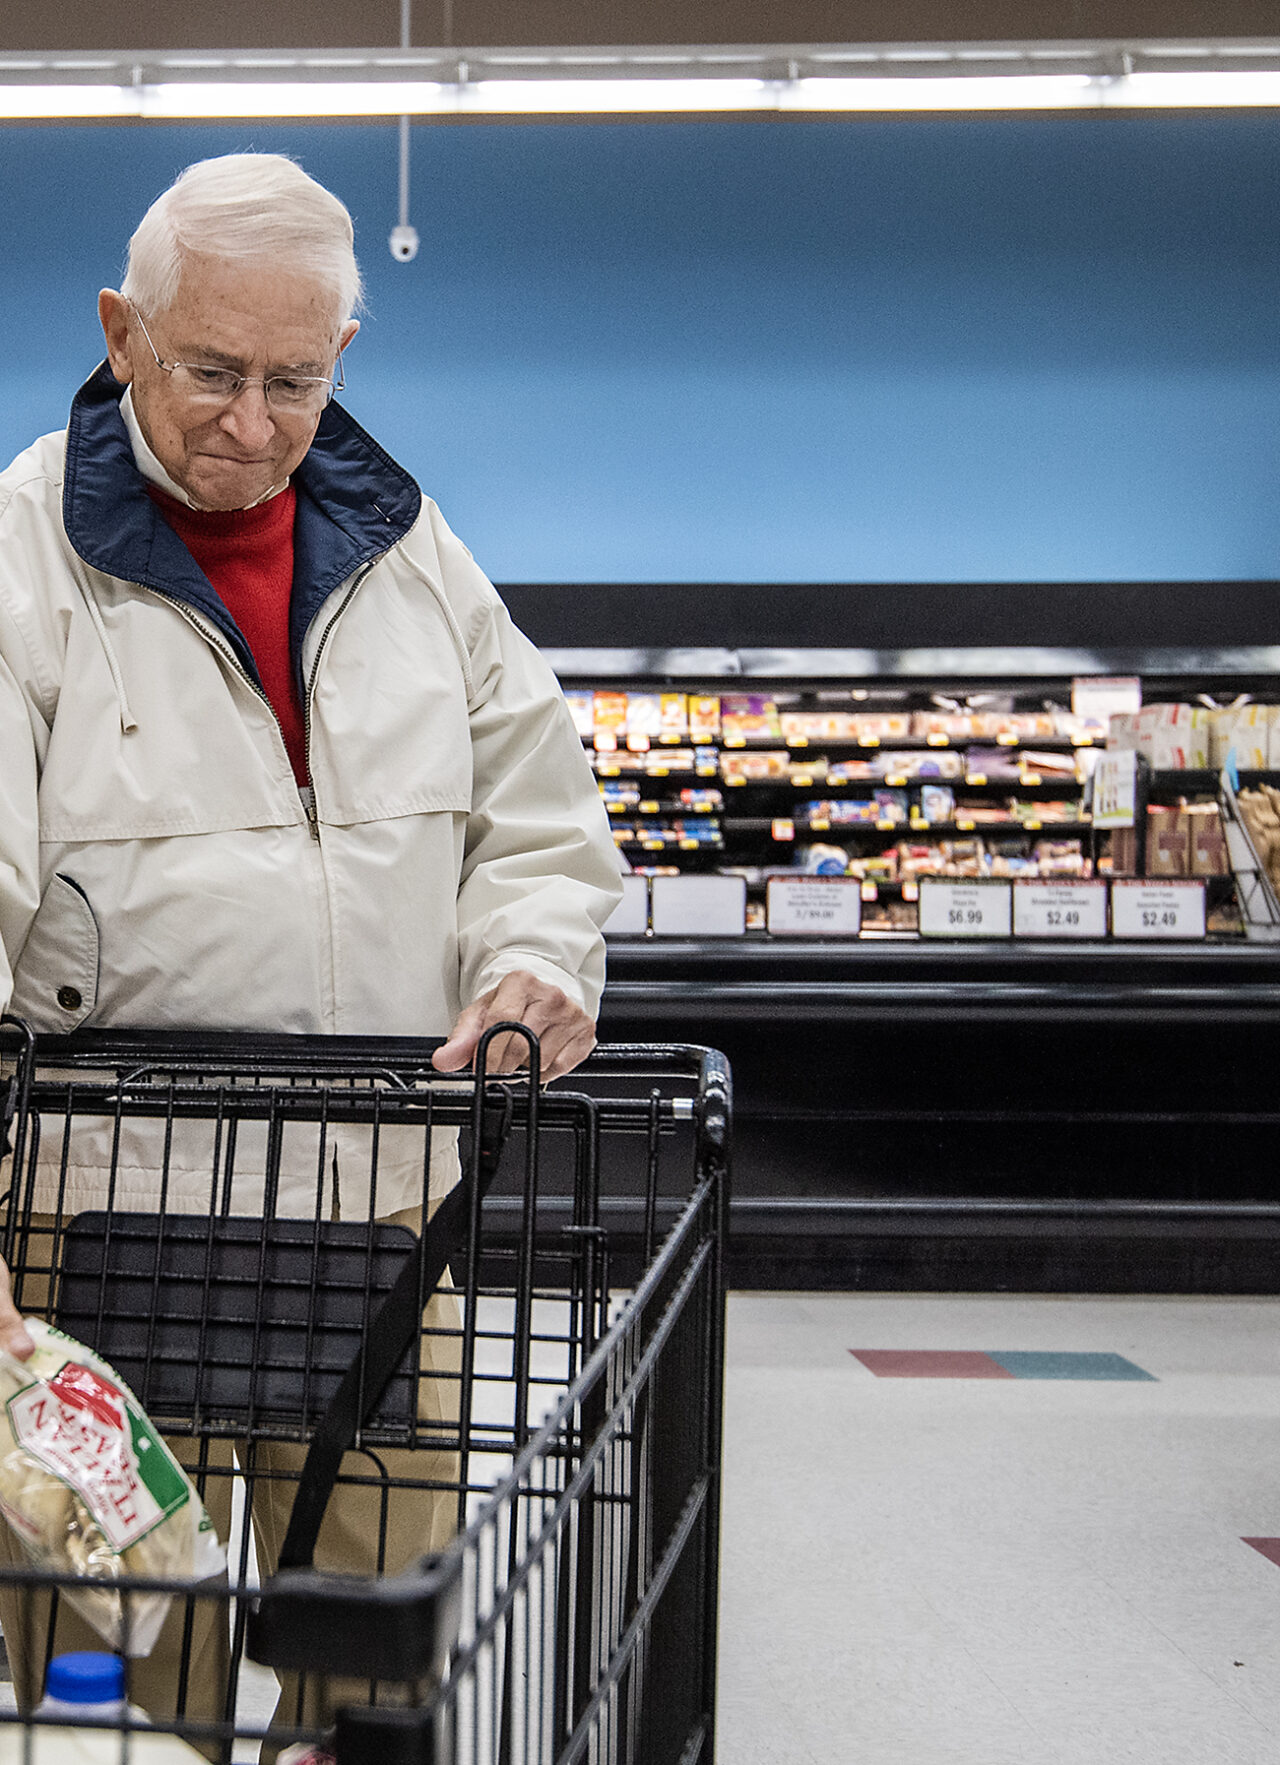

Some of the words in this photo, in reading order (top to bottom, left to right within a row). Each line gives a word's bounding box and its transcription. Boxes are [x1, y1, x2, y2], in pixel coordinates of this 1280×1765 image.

[949, 910, 983, 924] $6.99
[1047, 911, 1080, 925] $2.49
[1142, 911, 1177, 927] $2.49
